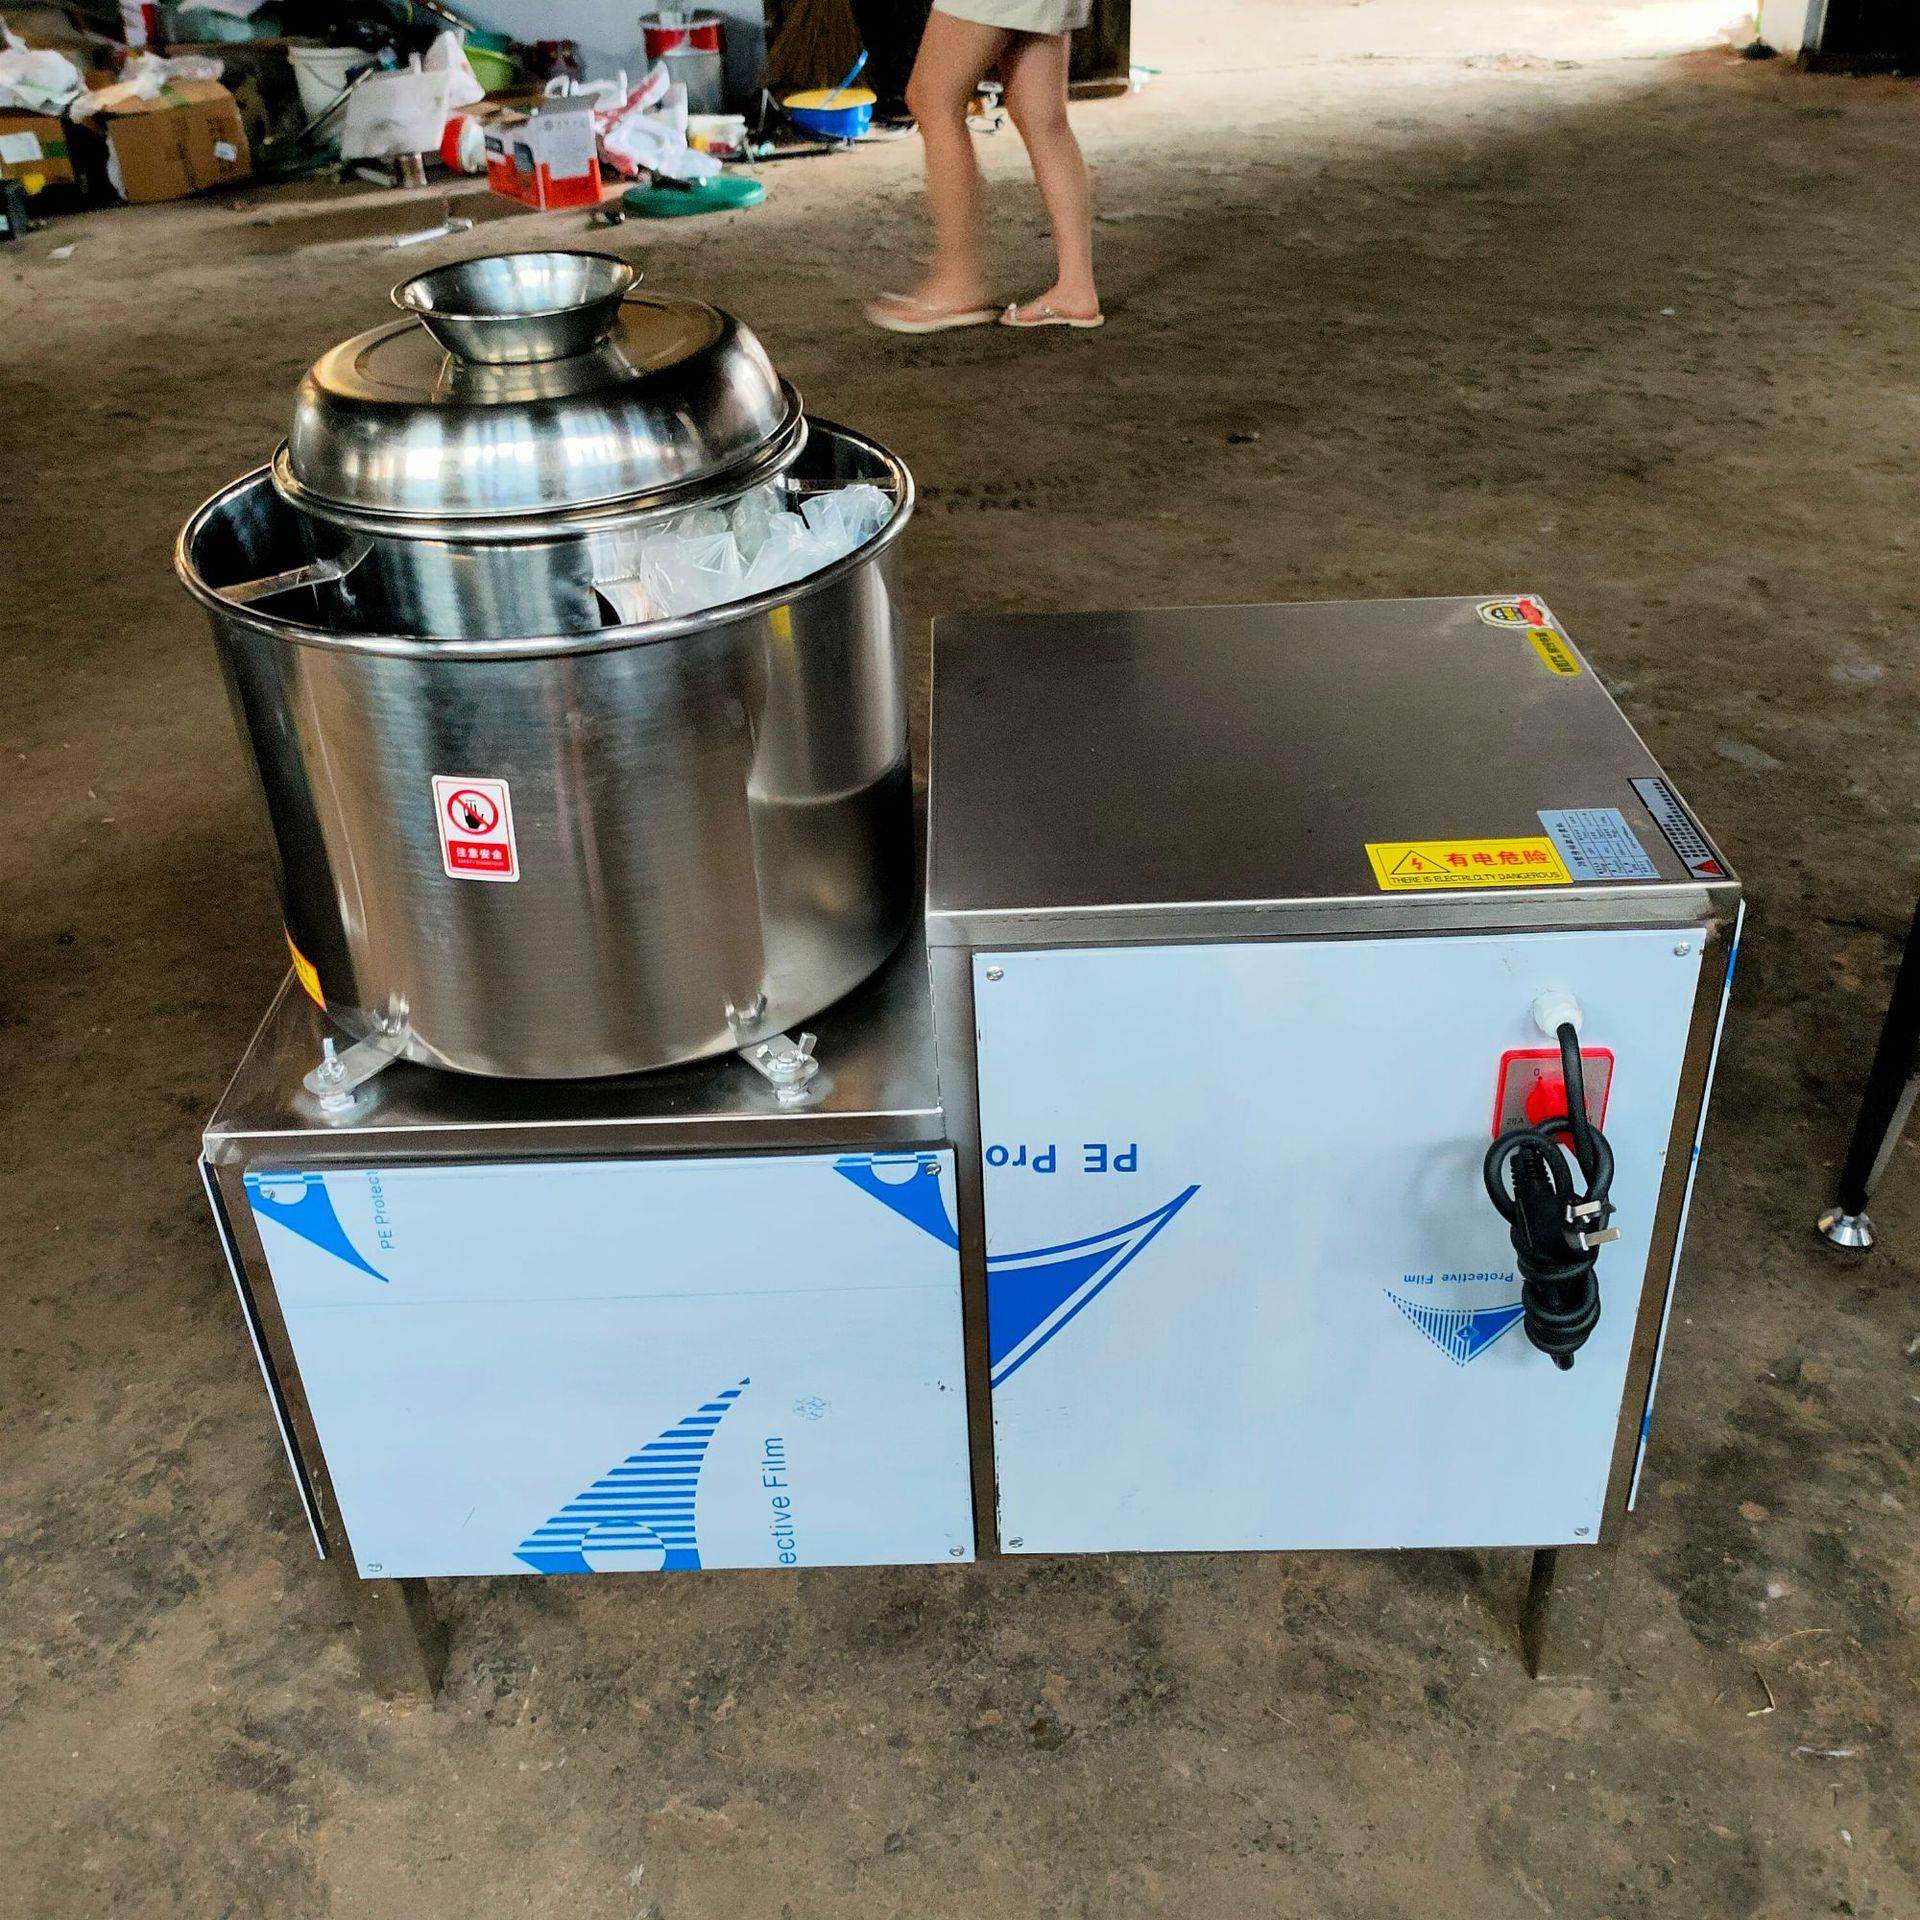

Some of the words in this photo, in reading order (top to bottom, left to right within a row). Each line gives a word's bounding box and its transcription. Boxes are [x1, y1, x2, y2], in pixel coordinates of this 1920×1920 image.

[1445, 850, 1550, 867] 有电危险
[1390, 875, 1420, 884] THERE
[1422, 875, 1432, 883] IS
[1498, 871, 1560, 881] DANGEROUS
[985, 1144, 1057, 1174] Pro
[1083, 1143, 1138, 1173] PE
[378, 1229, 395, 1250] PE
[1403, 1274, 1434, 1285] Film
[1441, 1272, 1514, 1283] Protective
[761, 1437, 789, 1488] Film
[769, 1496, 797, 1565] ective
